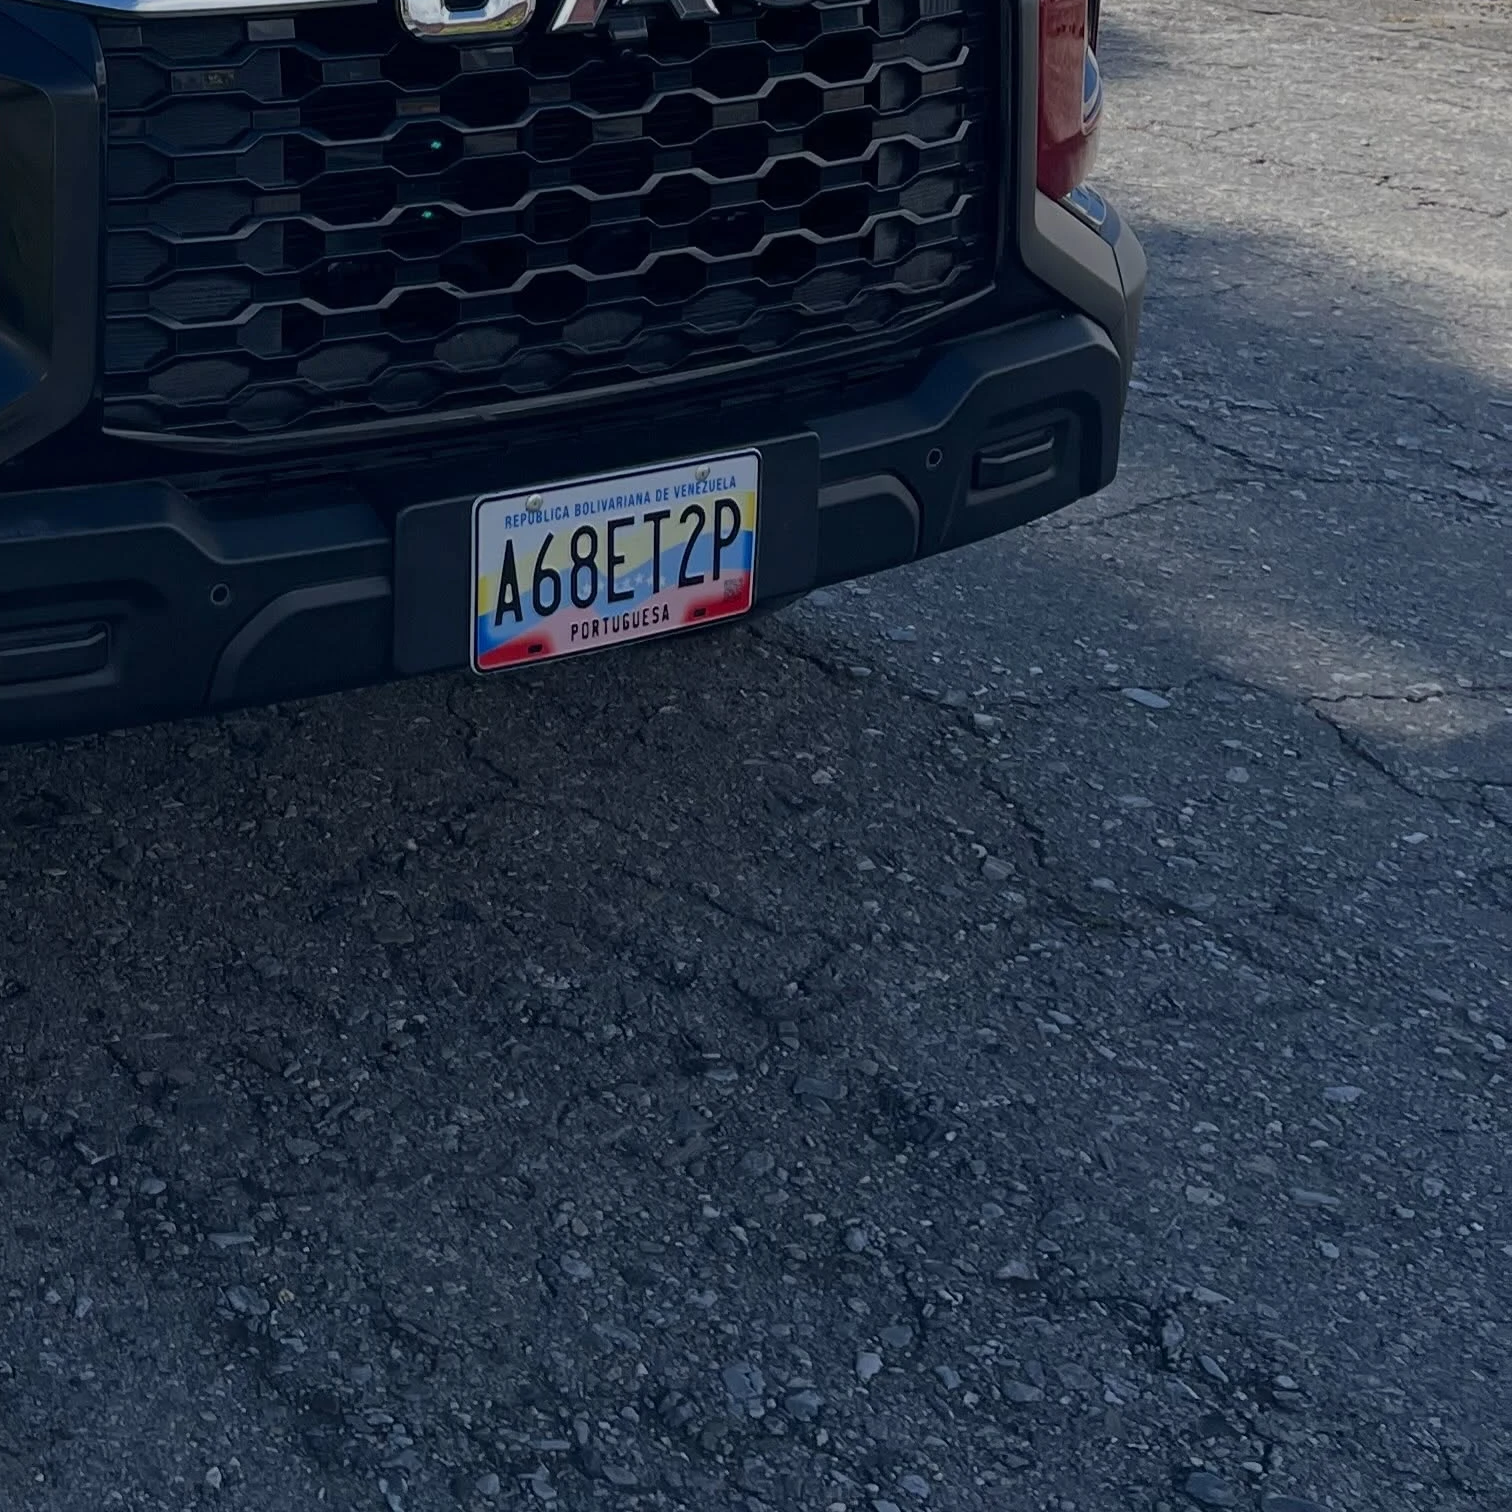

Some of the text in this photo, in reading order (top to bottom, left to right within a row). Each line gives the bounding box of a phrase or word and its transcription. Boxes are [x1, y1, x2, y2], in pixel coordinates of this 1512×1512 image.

[574, 492, 651, 516] BOLIVARIANA
[655, 489, 670, 502] DE
[673, 476, 737, 499] VENEZUELA
[494, 498, 742, 626] A68ET2P
[571, 604, 670, 641] PORTUGUESA
